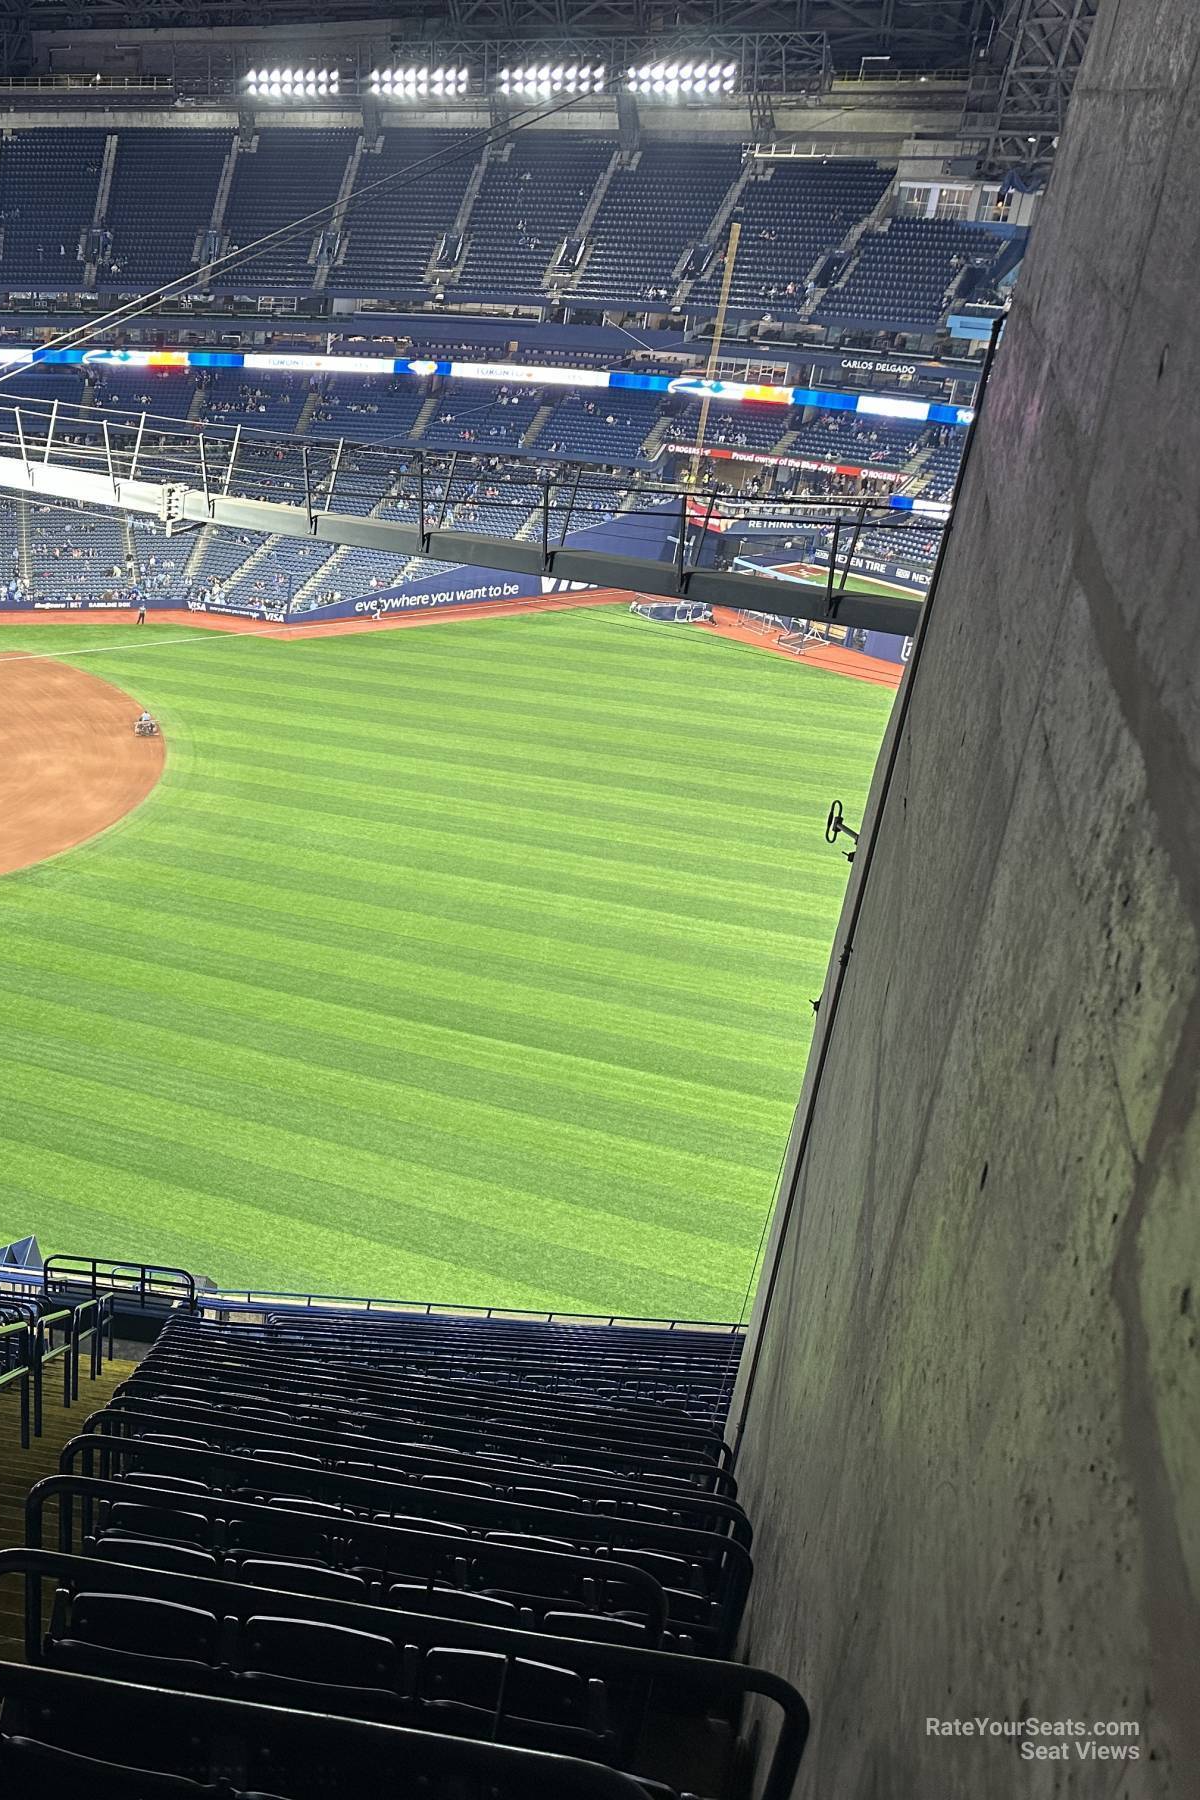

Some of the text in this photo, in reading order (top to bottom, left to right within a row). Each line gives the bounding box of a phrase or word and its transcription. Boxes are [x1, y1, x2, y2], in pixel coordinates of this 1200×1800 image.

[841, 359, 916, 374] CARLOS DELGADO
[675, 446, 896, 481] ROGERS Proud owner of the Blue Jays ROGERS
[748, 521, 795, 529] RETHINK
[865, 560, 887, 573] TIRE
[430, 590, 458, 606] you
[459, 586, 488, 600] want
[488, 584, 502, 596] to
[503, 583, 520, 595] be
[187, 601, 207, 611] VISA
[264, 612, 285, 622] VISA
